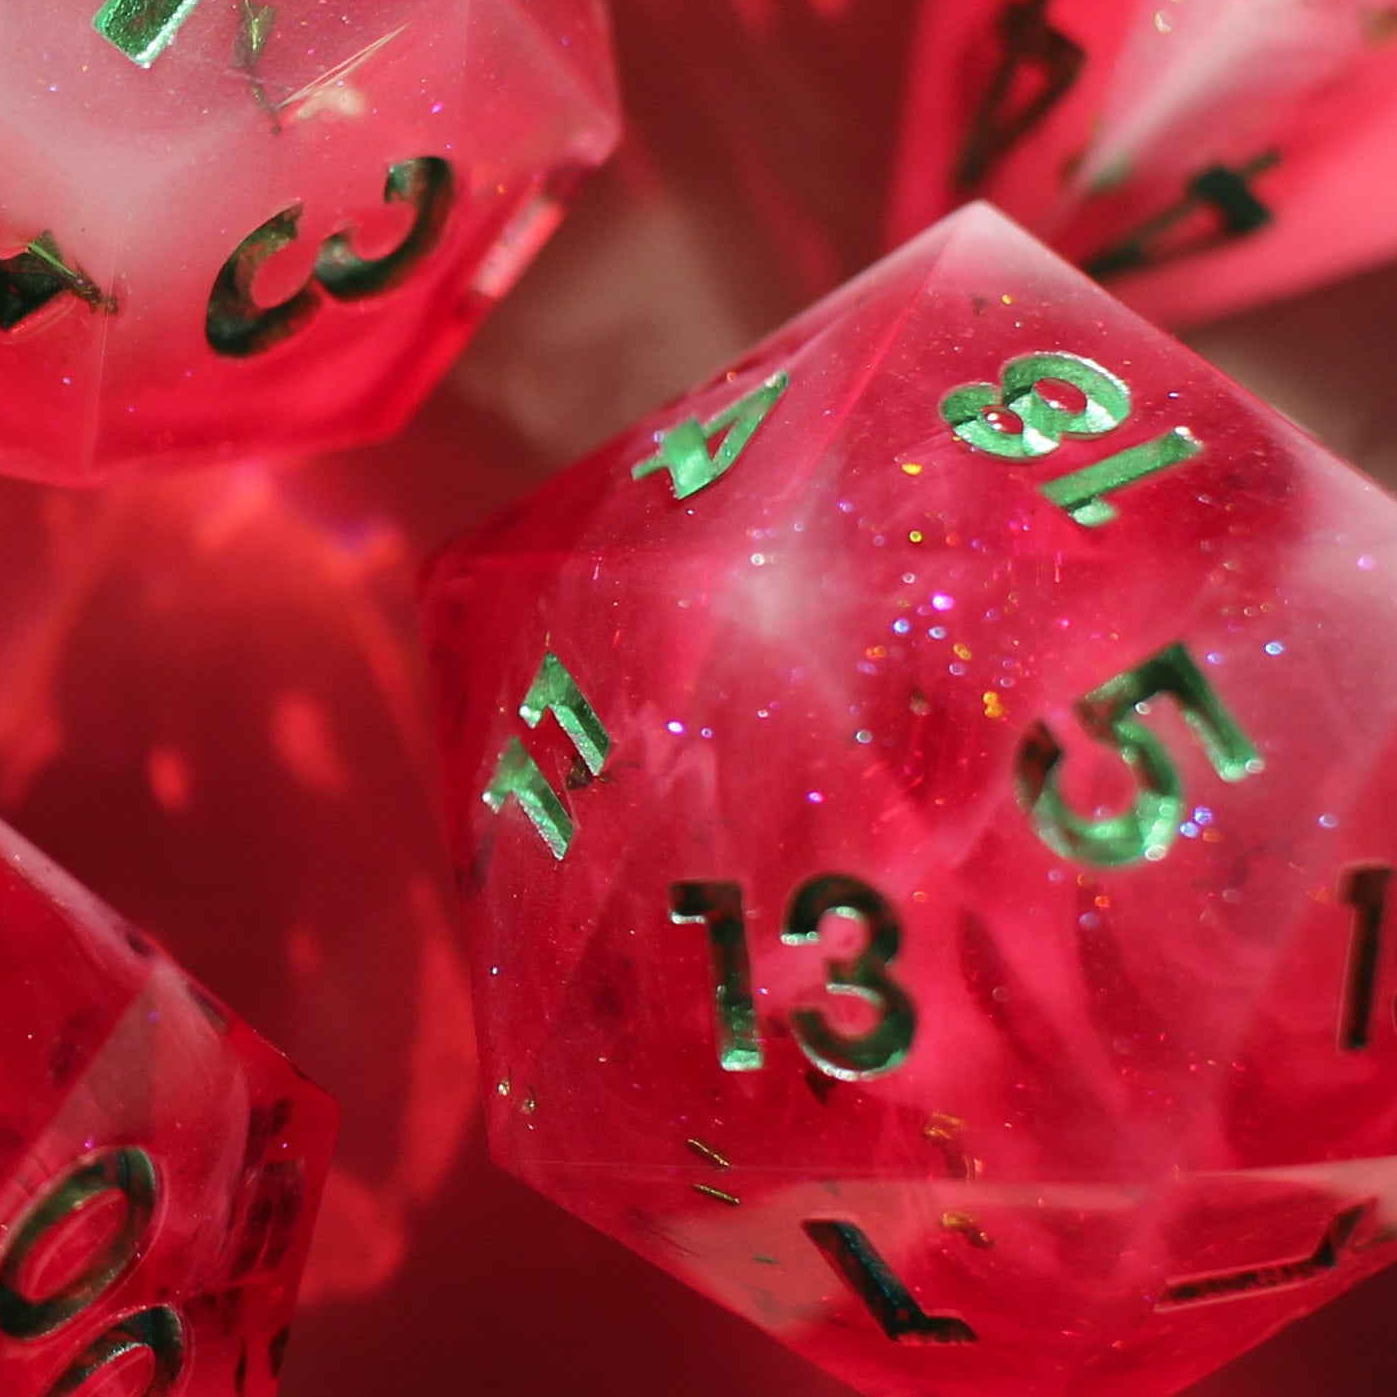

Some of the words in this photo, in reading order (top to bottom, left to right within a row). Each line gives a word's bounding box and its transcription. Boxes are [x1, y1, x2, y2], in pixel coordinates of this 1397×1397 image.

[205, 155, 454, 359] 3
[631, 369, 790, 500] 4
[938, 350, 1204, 529] 18
[481, 650, 608, 861] 11
[1014, 640, 1264, 870] 5
[669, 872, 920, 1082] 13
[1339, 862, 1397, 1052] 1
